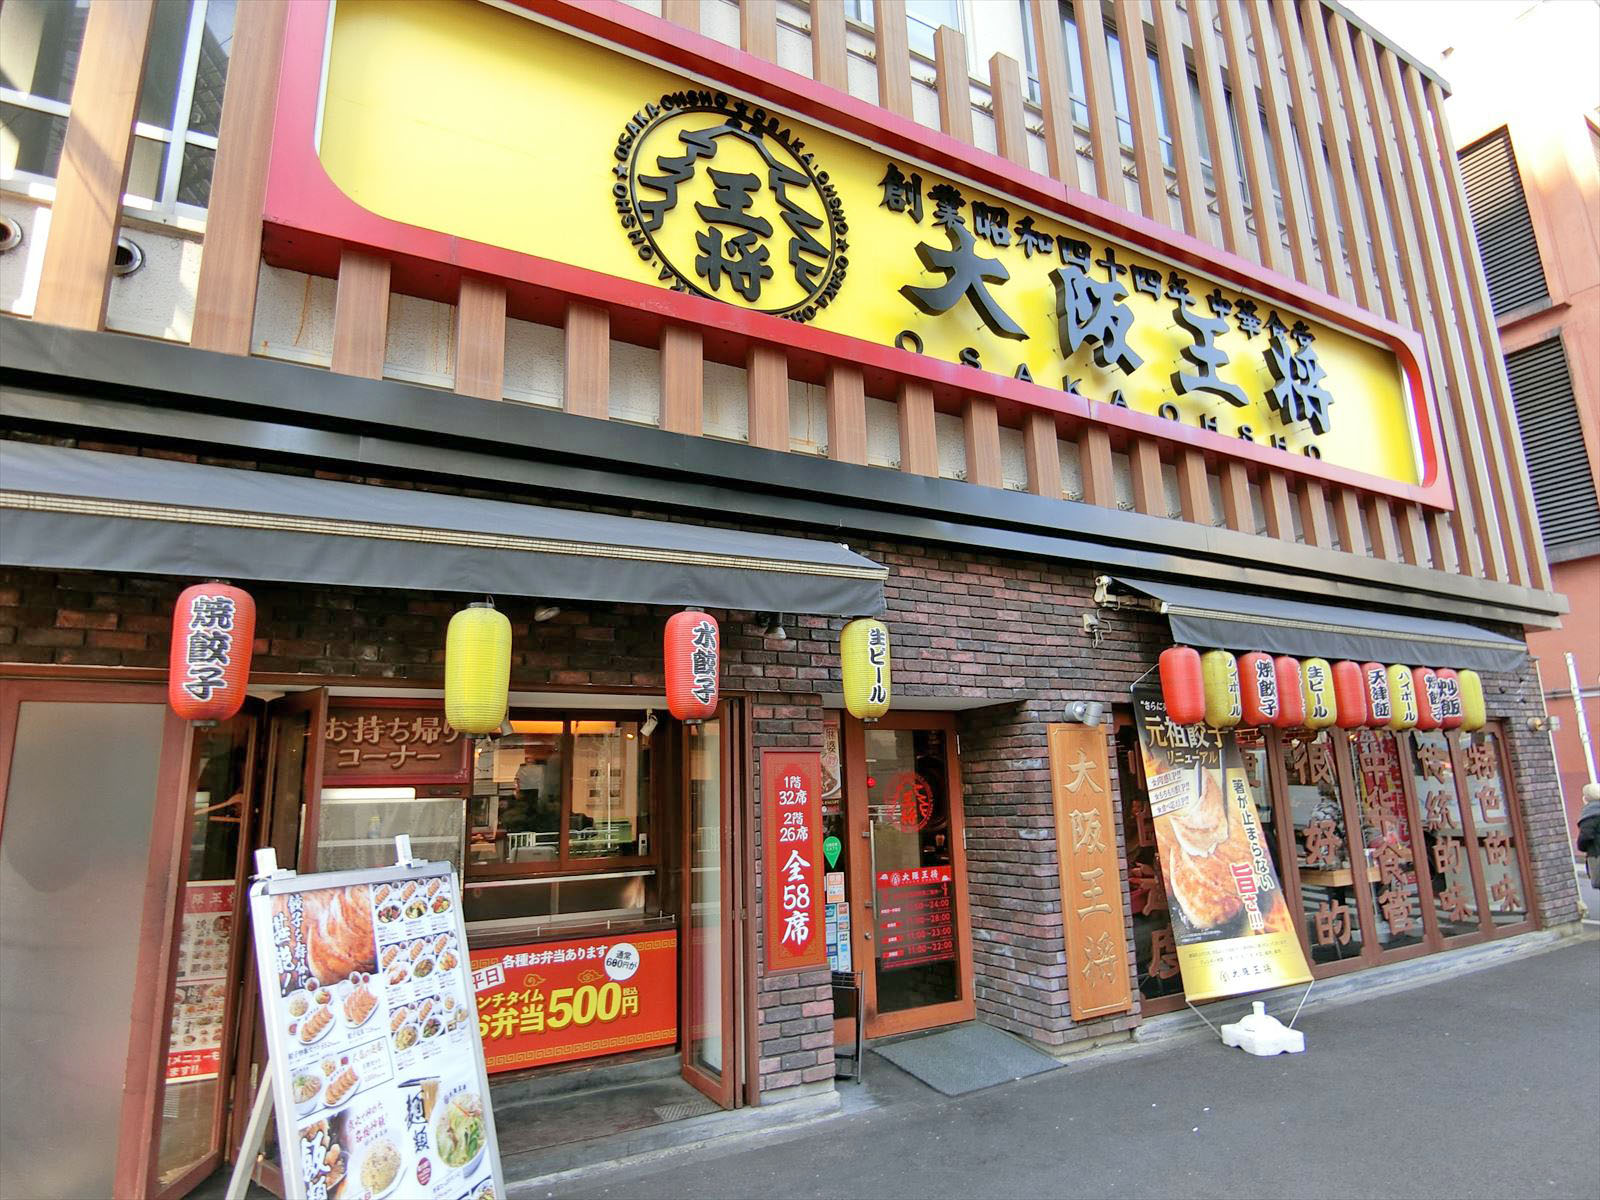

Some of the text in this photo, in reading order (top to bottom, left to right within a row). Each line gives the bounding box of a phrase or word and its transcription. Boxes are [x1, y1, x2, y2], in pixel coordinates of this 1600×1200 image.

[694, 166, 774, 302] 王将
[879, 162, 1317, 352] 創業昭和四十四年 中華食堂
[898, 225, 1335, 436] 大阪王将
[182, 595, 235, 702] 焼餃子
[691, 620, 717, 705] 水餃子
[868, 627, 889, 705] 生ビール
[1255, 659, 1279, 718] 焼餃子
[1307, 665, 1328, 718] 生ビール
[1368, 668, 1392, 719] 天津飯
[1397, 671, 1416, 722] ハイボール
[1436, 677, 1461, 719] 炒飯
[324, 714, 460, 745] お持ち帰り
[337, 743, 442, 769] コーナー
[1166, 749, 1219, 766] リニューアル
[778, 788, 808, 806] 32席
[783, 775, 802, 790] 1階
[779, 827, 809, 843] 26席
[783, 812, 804, 826] 2階
[1231, 778, 1276, 892] 箸が止まらない
[1063, 747, 1118, 988] 大阪王将
[472, 967, 503, 991] 平日
[502, 944, 609, 969] 各種お弁当あります
